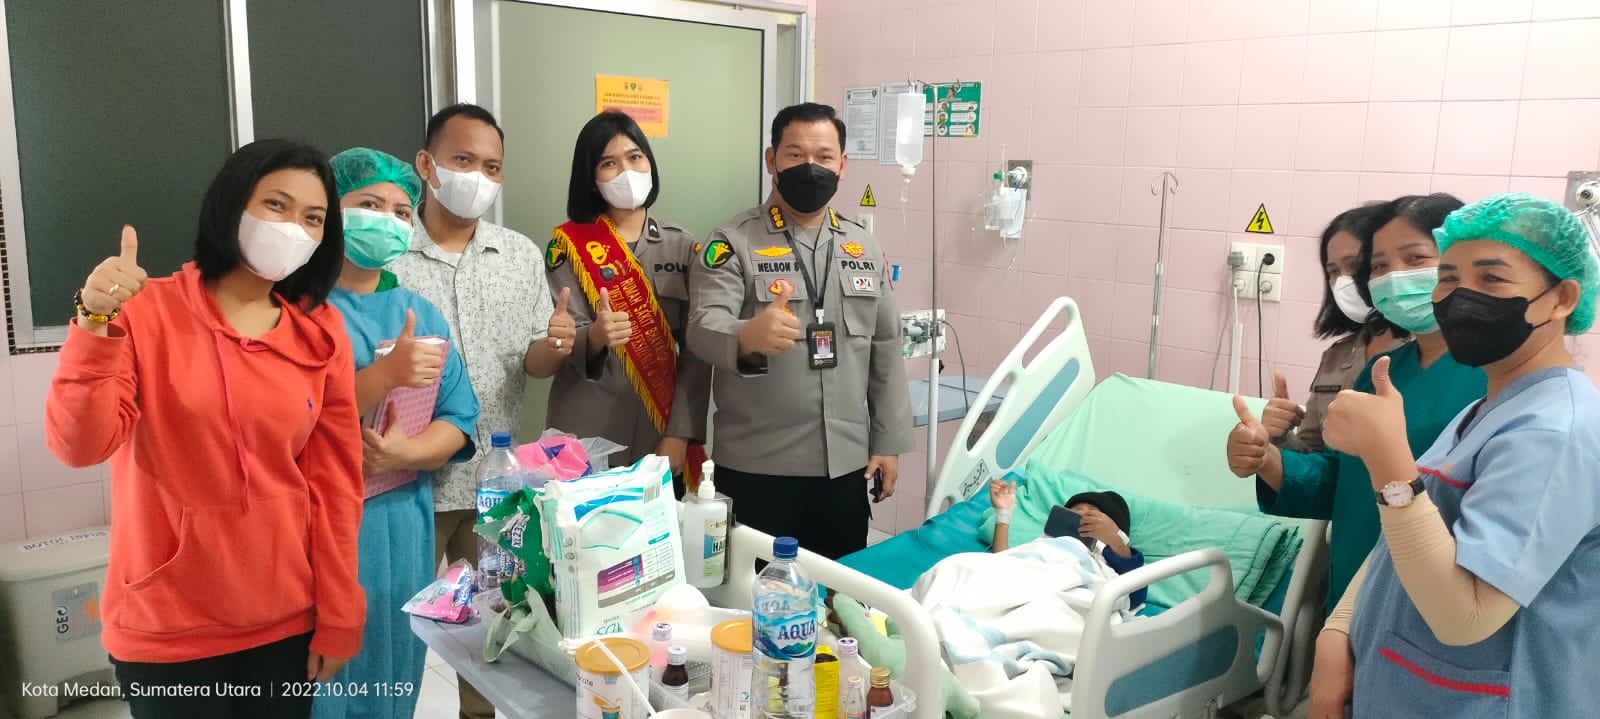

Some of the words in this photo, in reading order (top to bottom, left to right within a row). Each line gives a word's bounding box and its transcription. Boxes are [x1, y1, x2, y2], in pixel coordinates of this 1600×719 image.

[757, 261, 791, 273] NELSON
[841, 260, 875, 271] POLRI
[620, 277, 642, 306] RUMAH
[777, 618, 816, 641] AQUA
